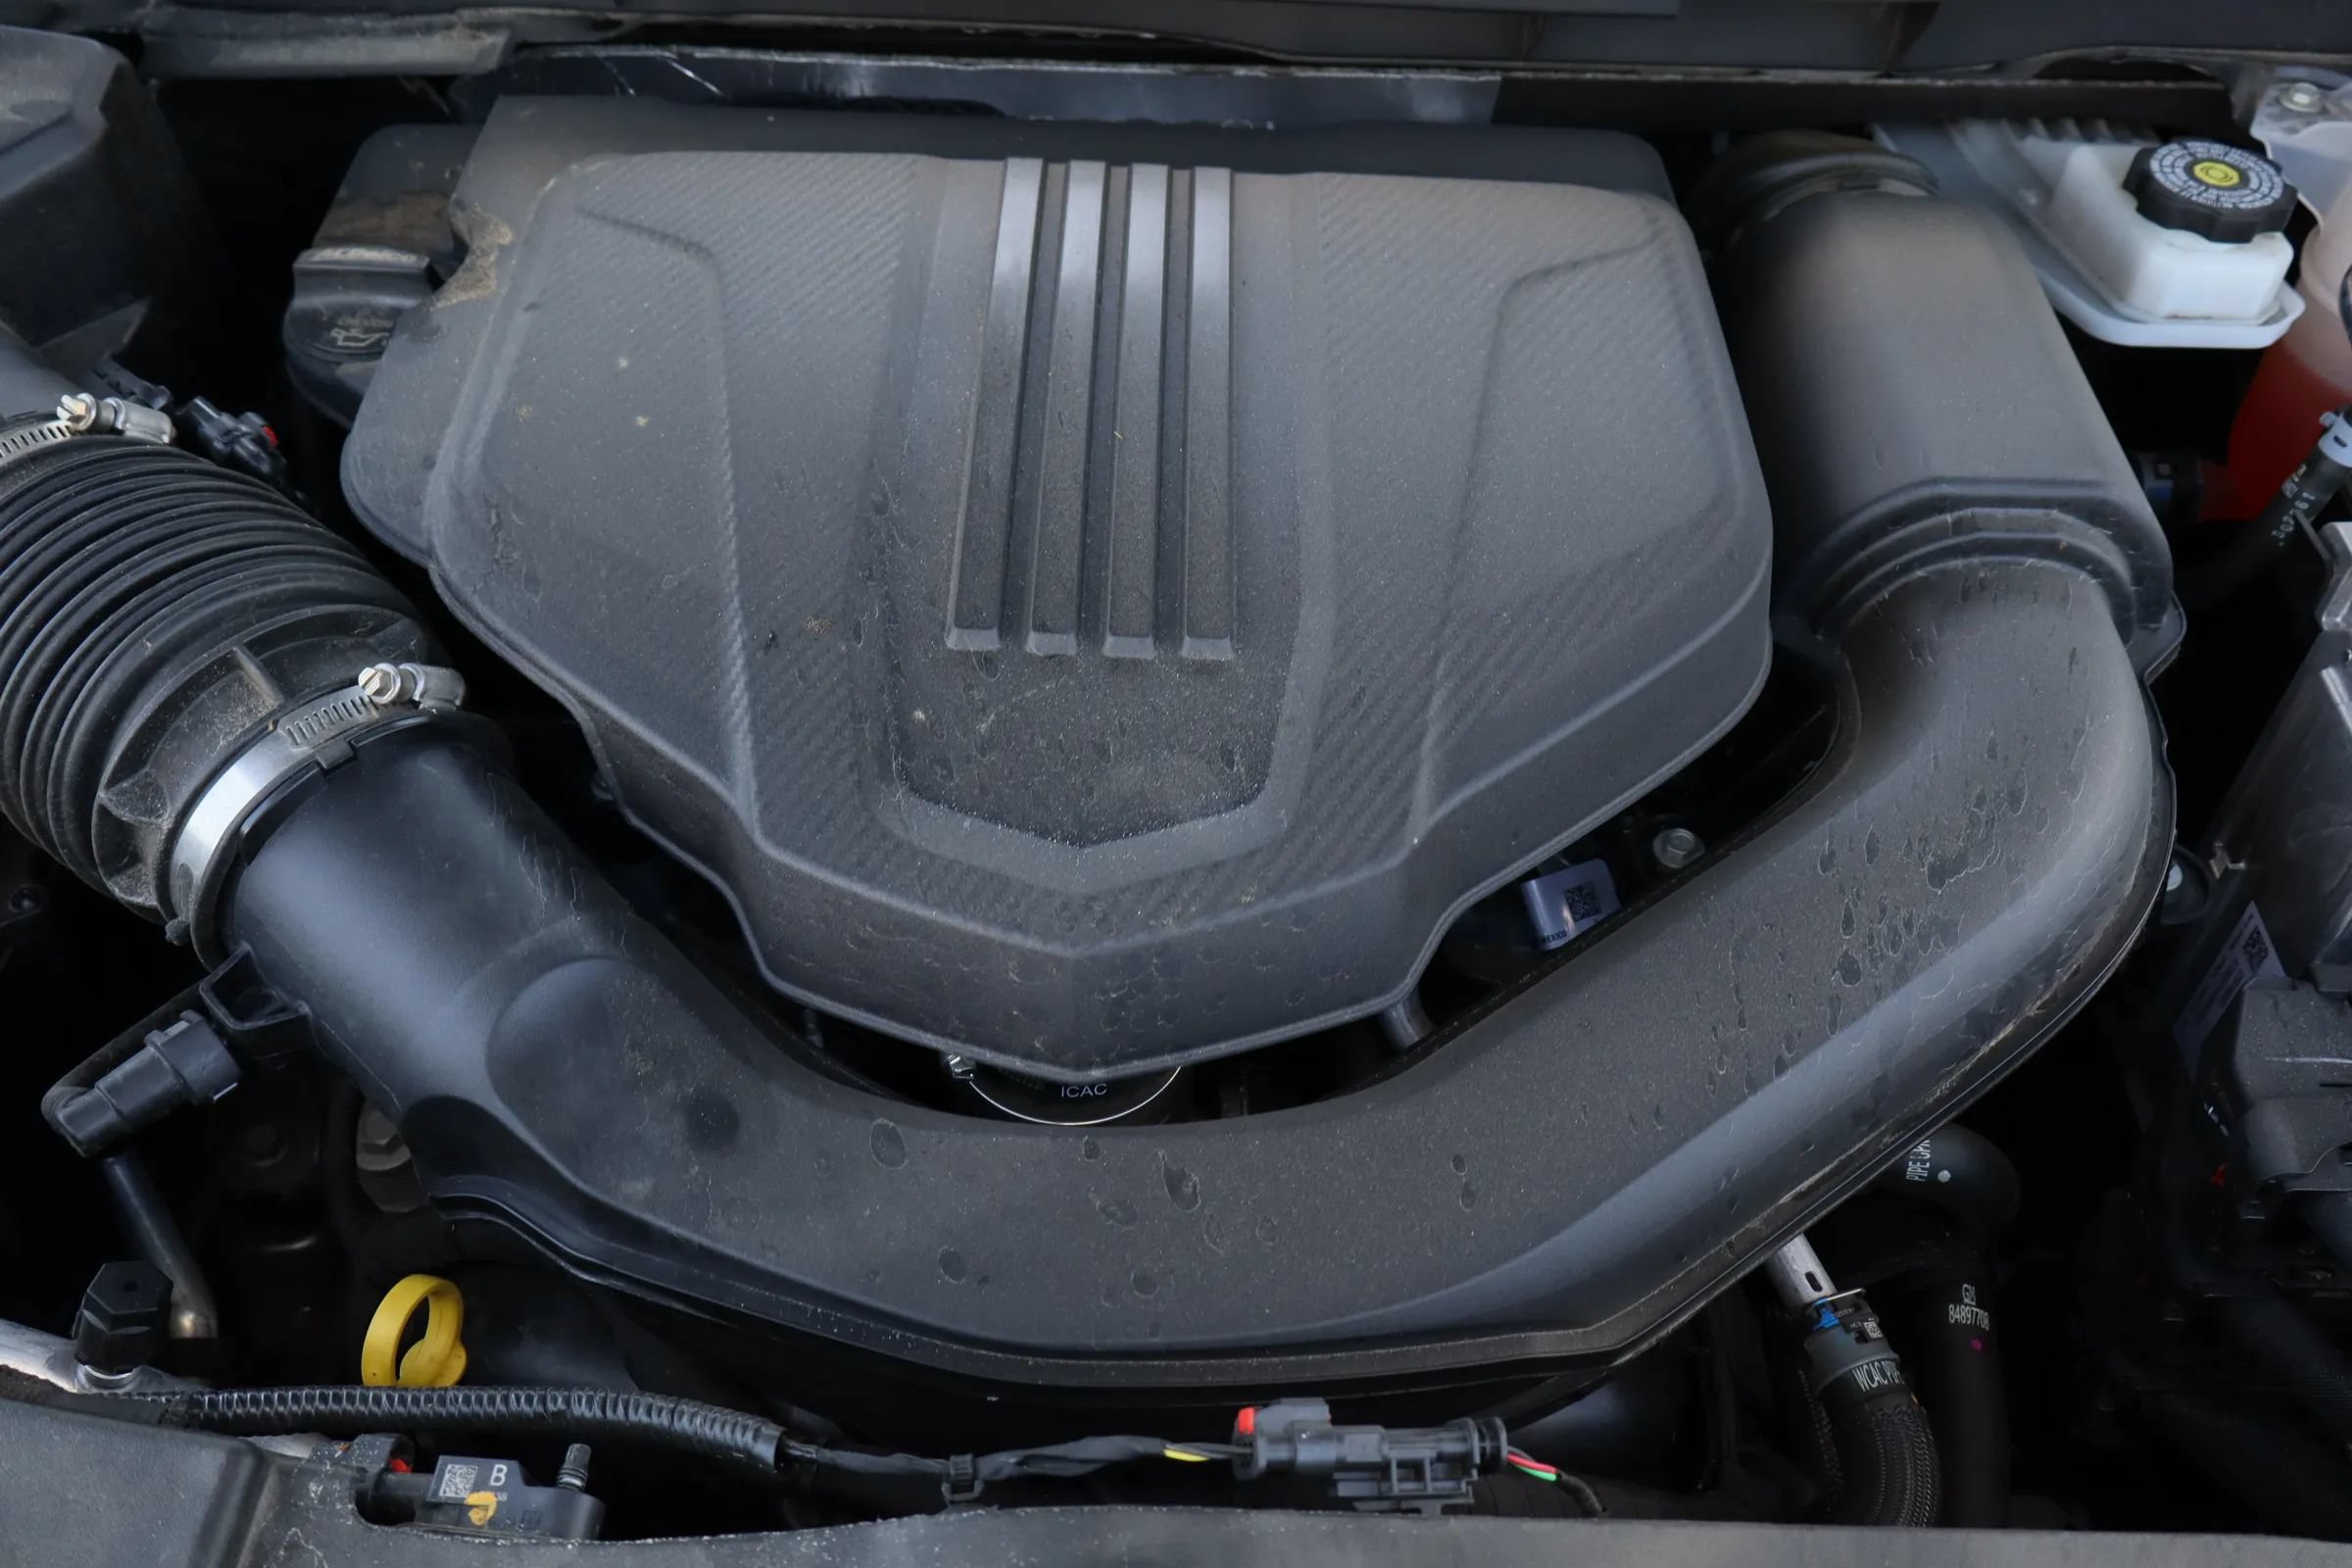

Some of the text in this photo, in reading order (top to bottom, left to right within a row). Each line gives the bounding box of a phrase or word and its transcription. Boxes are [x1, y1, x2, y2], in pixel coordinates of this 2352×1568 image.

[1061, 1083, 1107, 1098] ICAC
[1905, 1160, 1930, 1182] PIPE
[1851, 1360, 1888, 1392] WCAC
[490, 1463, 509, 1487] B
